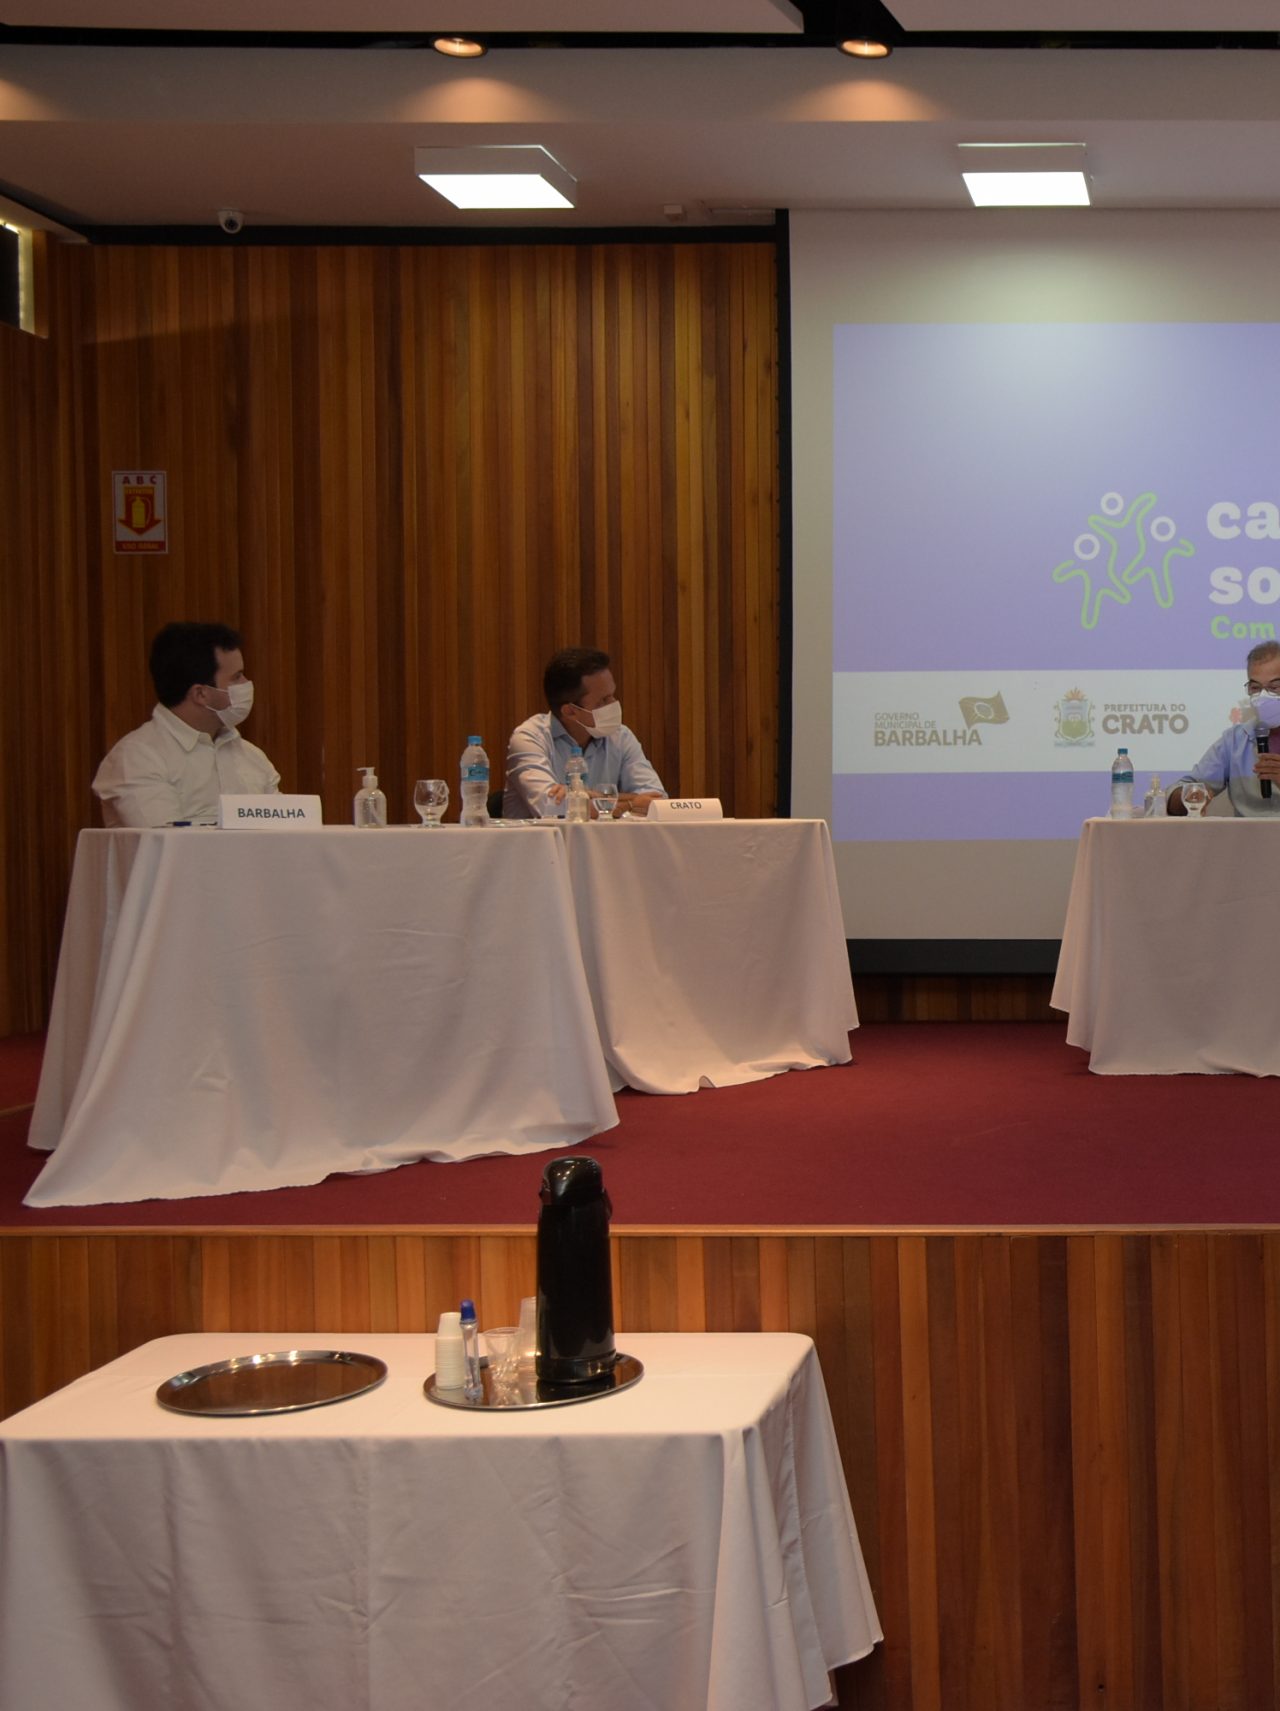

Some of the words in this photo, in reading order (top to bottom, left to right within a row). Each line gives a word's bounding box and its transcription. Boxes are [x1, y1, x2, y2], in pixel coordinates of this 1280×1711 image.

[1210, 615, 1276, 640] Com
[1103, 703, 1167, 713] PREFEITURA
[1170, 703, 1187, 713] DO
[874, 712, 920, 721] GOVERNO
[875, 720, 923, 730] MUNICIPAL
[924, 720, 937, 729] DE
[1102, 713, 1189, 735] CRATO
[874, 729, 983, 747] BARBALHA
[670, 801, 702, 810] CRATO
[237, 807, 306, 819] BARBALHA
